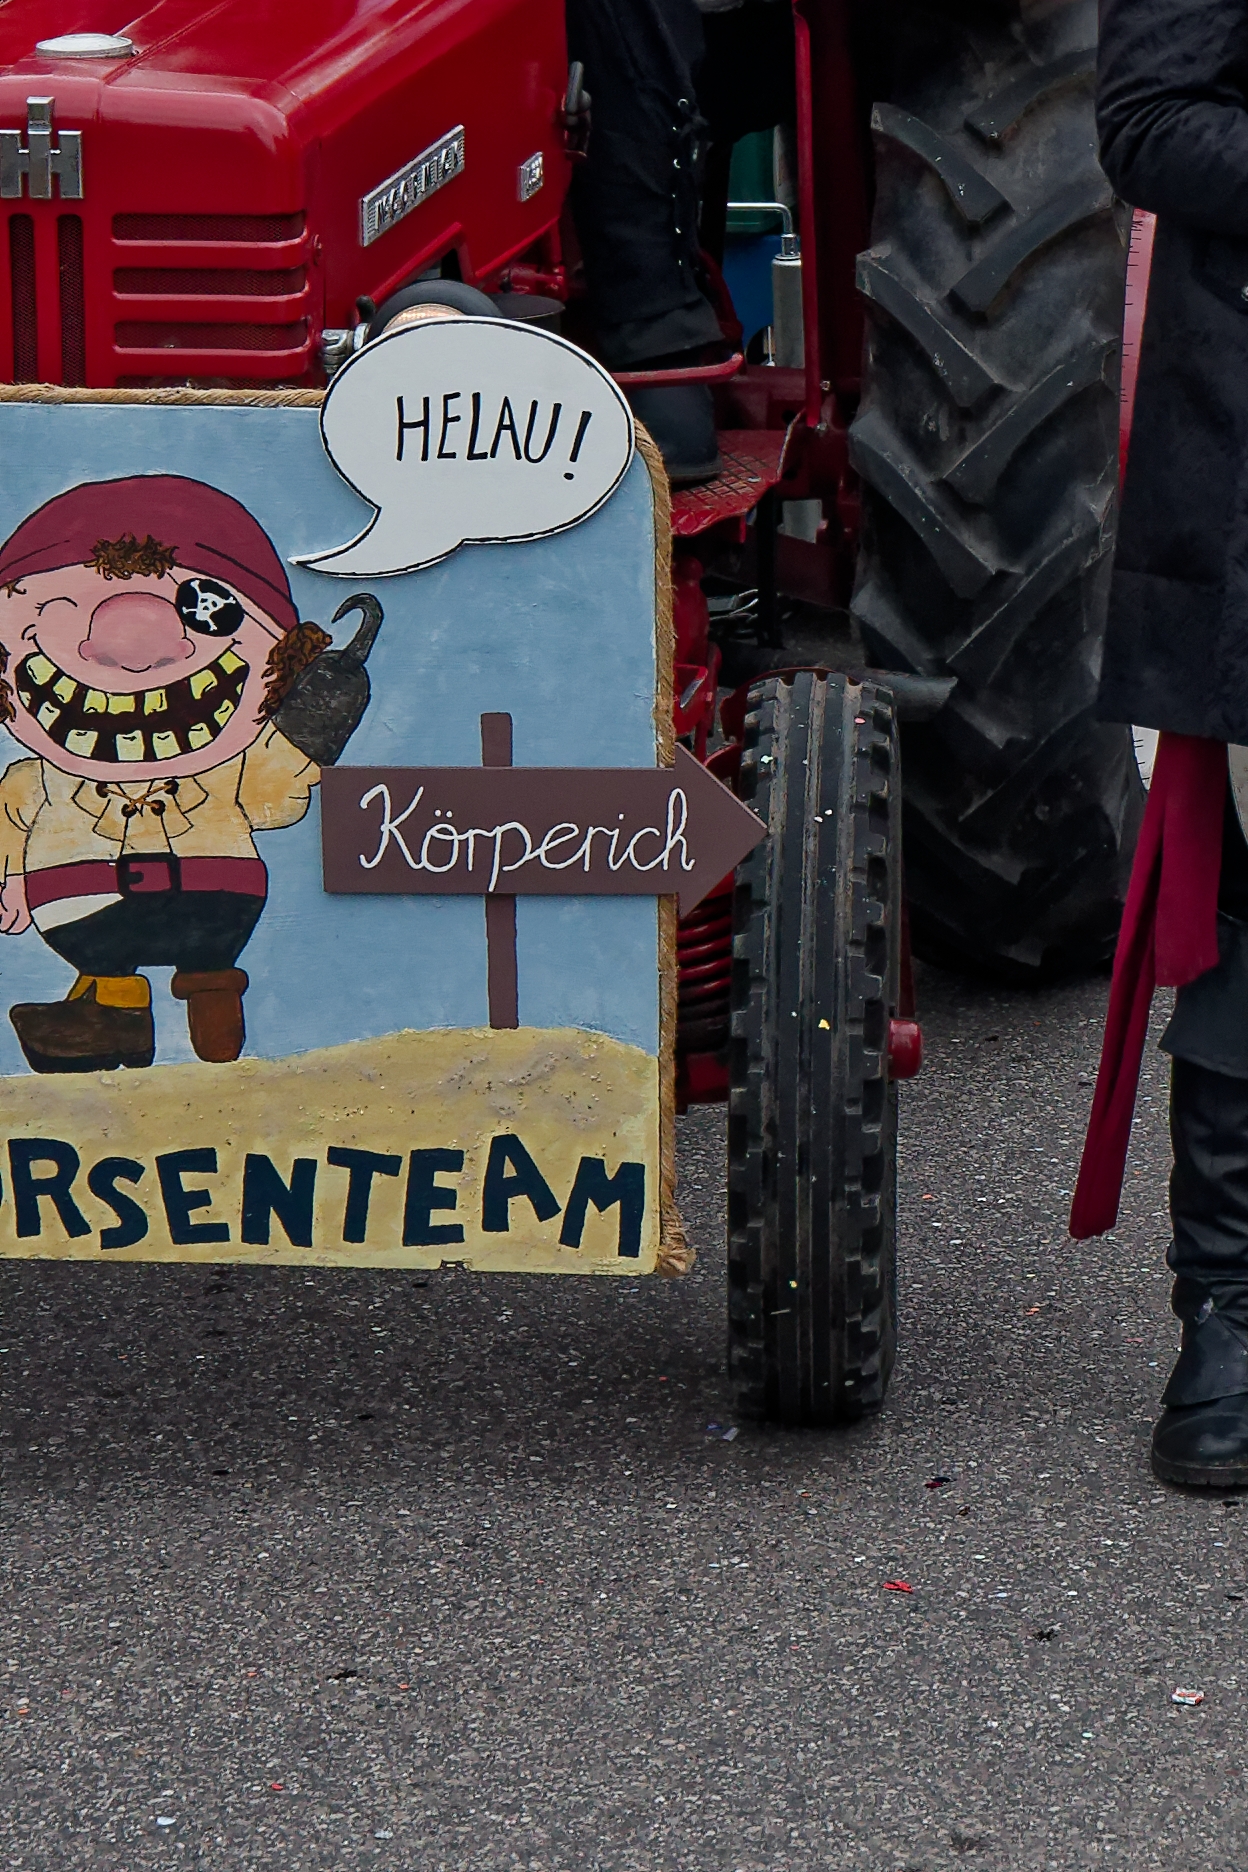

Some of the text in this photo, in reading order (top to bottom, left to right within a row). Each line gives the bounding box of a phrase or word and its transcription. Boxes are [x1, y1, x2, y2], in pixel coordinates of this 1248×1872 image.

[396, 391, 593, 481] HELAU!
[358, 783, 695, 892] Körperich
[0, 1133, 645, 1259] RSENTEAM
